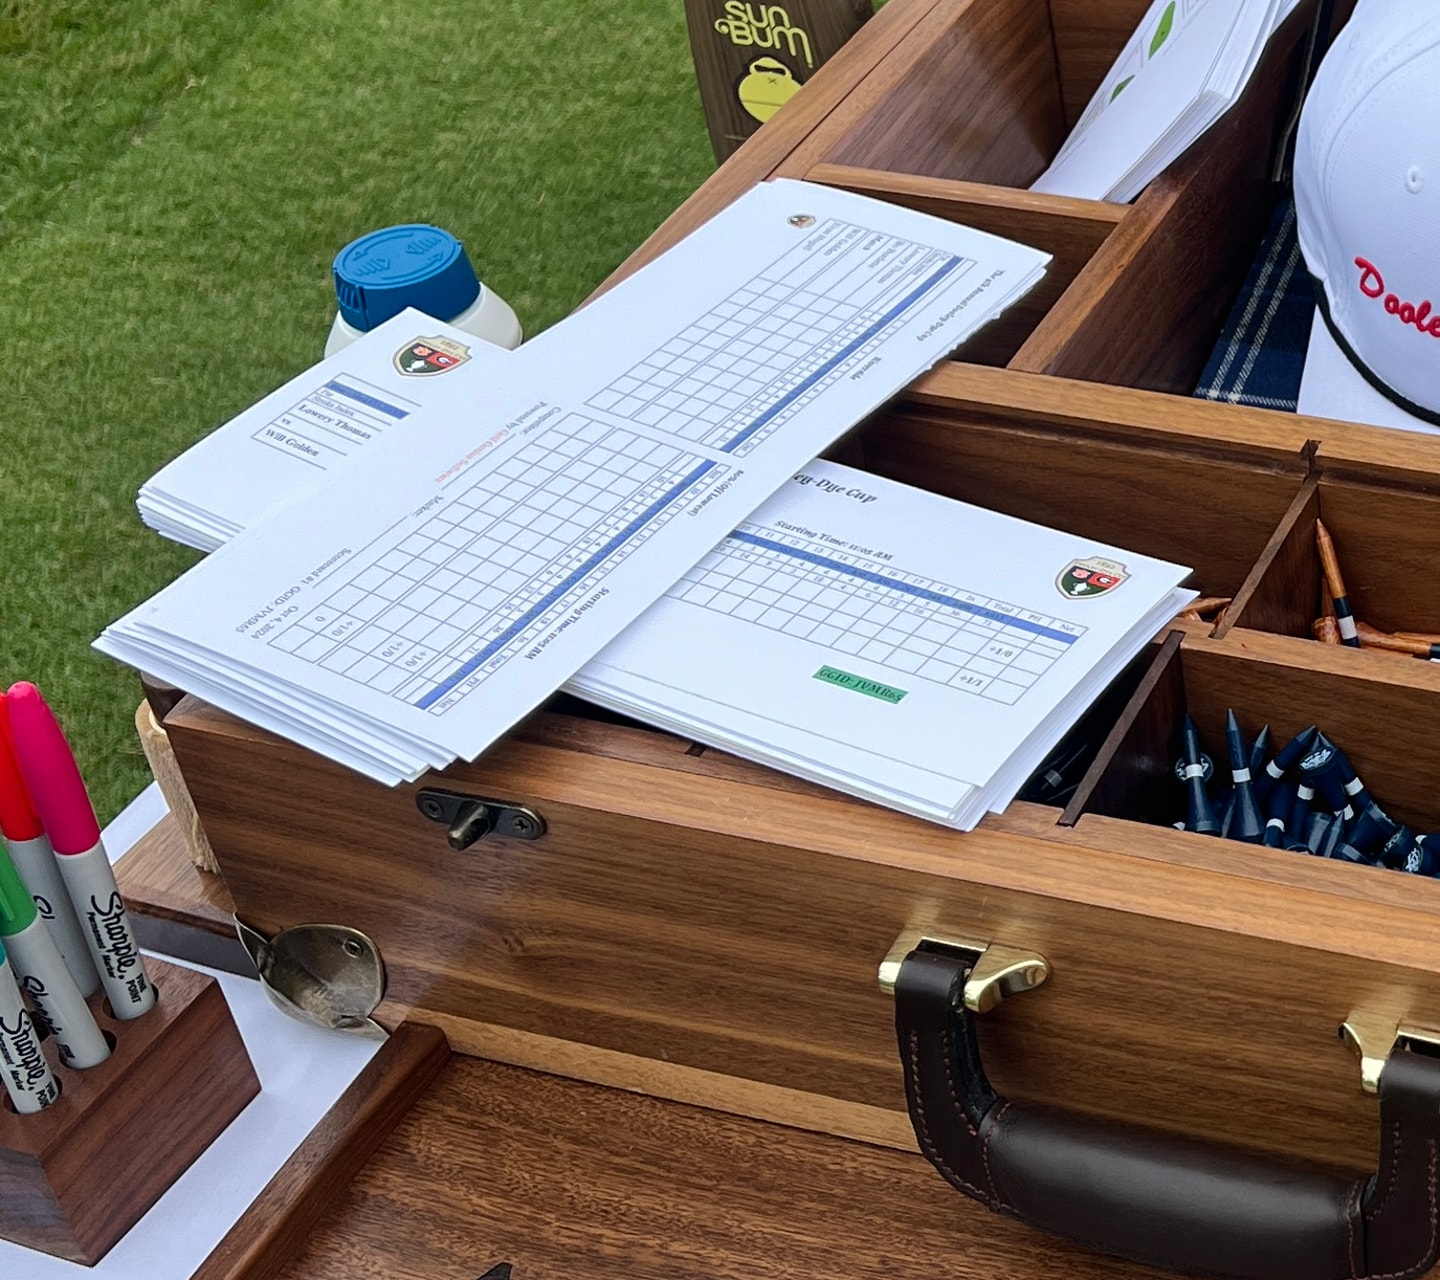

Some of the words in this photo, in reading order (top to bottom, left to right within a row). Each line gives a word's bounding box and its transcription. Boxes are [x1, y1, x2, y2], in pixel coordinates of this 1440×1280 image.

[297, 404, 334, 423] Lowery
[334, 419, 371, 439] Thomas
[265, 429, 287, 441] Will
[285, 438, 319, 456] Golden
[845, 488, 877, 504] Cup
[774, 520, 818, 538] Starting
[818, 532, 848, 547] Time:
[573, 587, 610, 615] Starting
[993, 602, 1014, 613] Total
[280, 605, 299, 617] Oct
[250, 622, 276, 640] 2024
[989, 646, 1013, 658] +1/0
[960, 675, 983, 687] +1/1
[126, 979, 142, 1004] POINT
